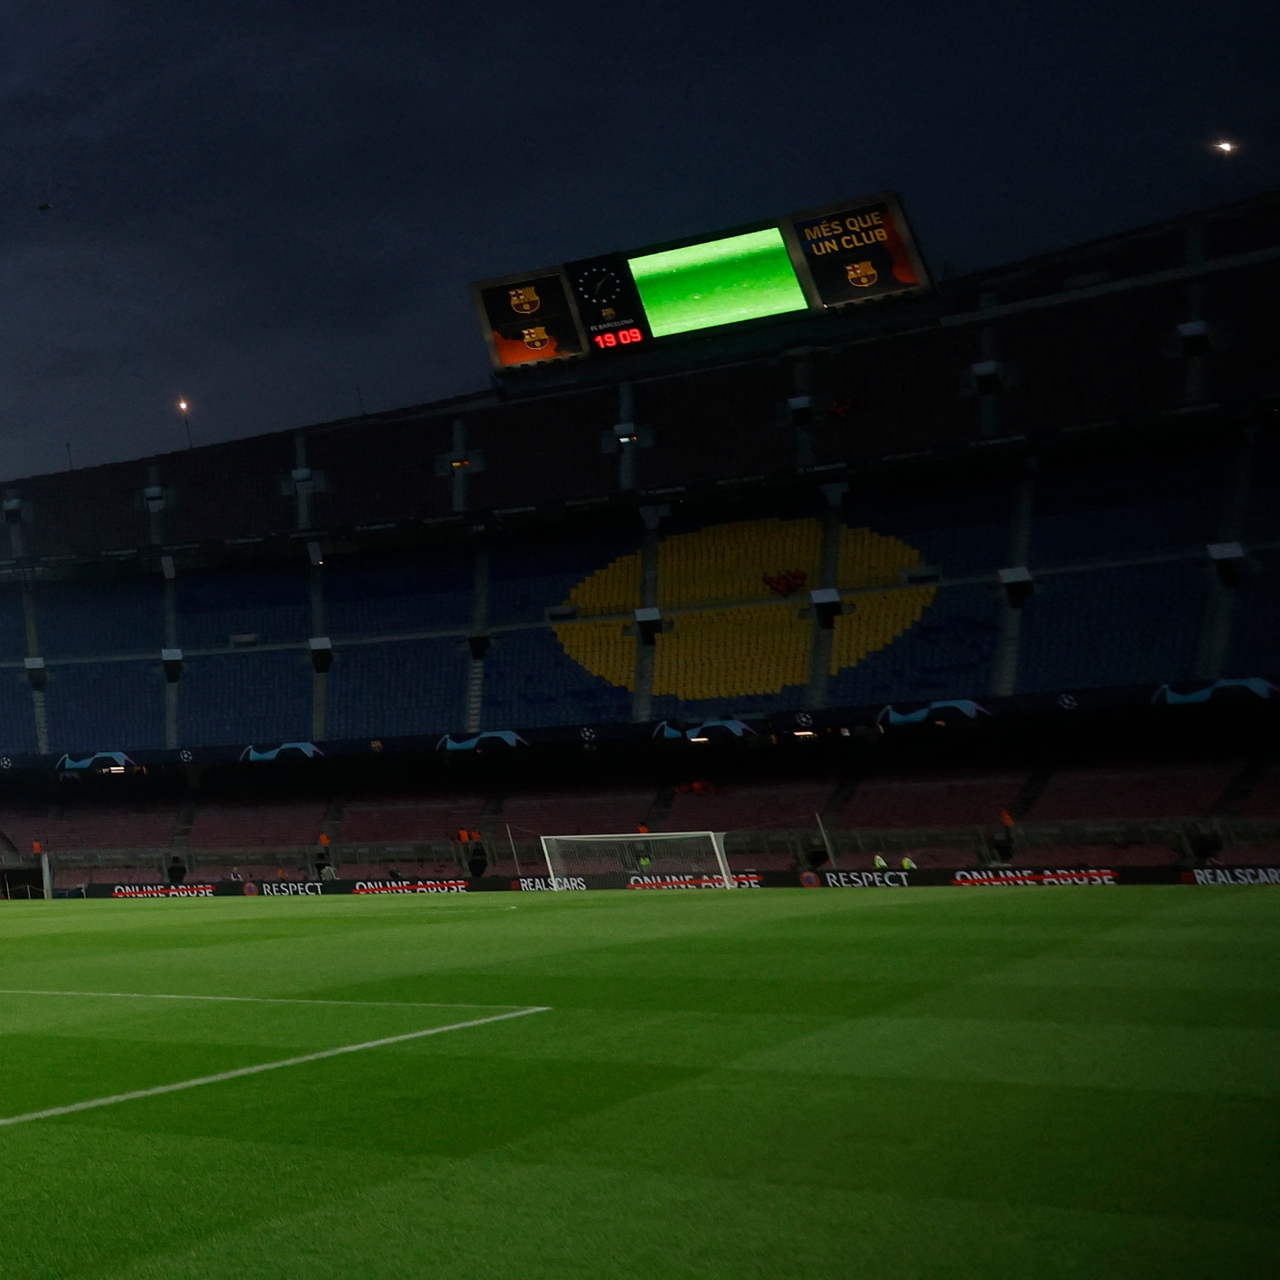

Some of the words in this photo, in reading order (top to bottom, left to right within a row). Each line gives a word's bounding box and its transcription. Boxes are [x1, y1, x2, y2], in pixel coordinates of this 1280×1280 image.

[804, 220, 843, 240] MÉS
[846, 211, 884, 232] QUE
[811, 239, 839, 255] UN
[841, 228, 888, 249] CLUB
[630, 874, 696, 889] ONLINE
[825, 871, 909, 887] RESPECT
[955, 870, 1037, 886] ONLINE
[1042, 869, 1115, 885] ABUSE
[1193, 868, 1280, 885] REALSCAR
[114, 885, 165, 897] ONLINE
[169, 884, 213, 897] ABUSE
[262, 882, 323, 896] RESPECT
[355, 881, 411, 894] ONLINE
[416, 880, 467, 893] ABUSE
